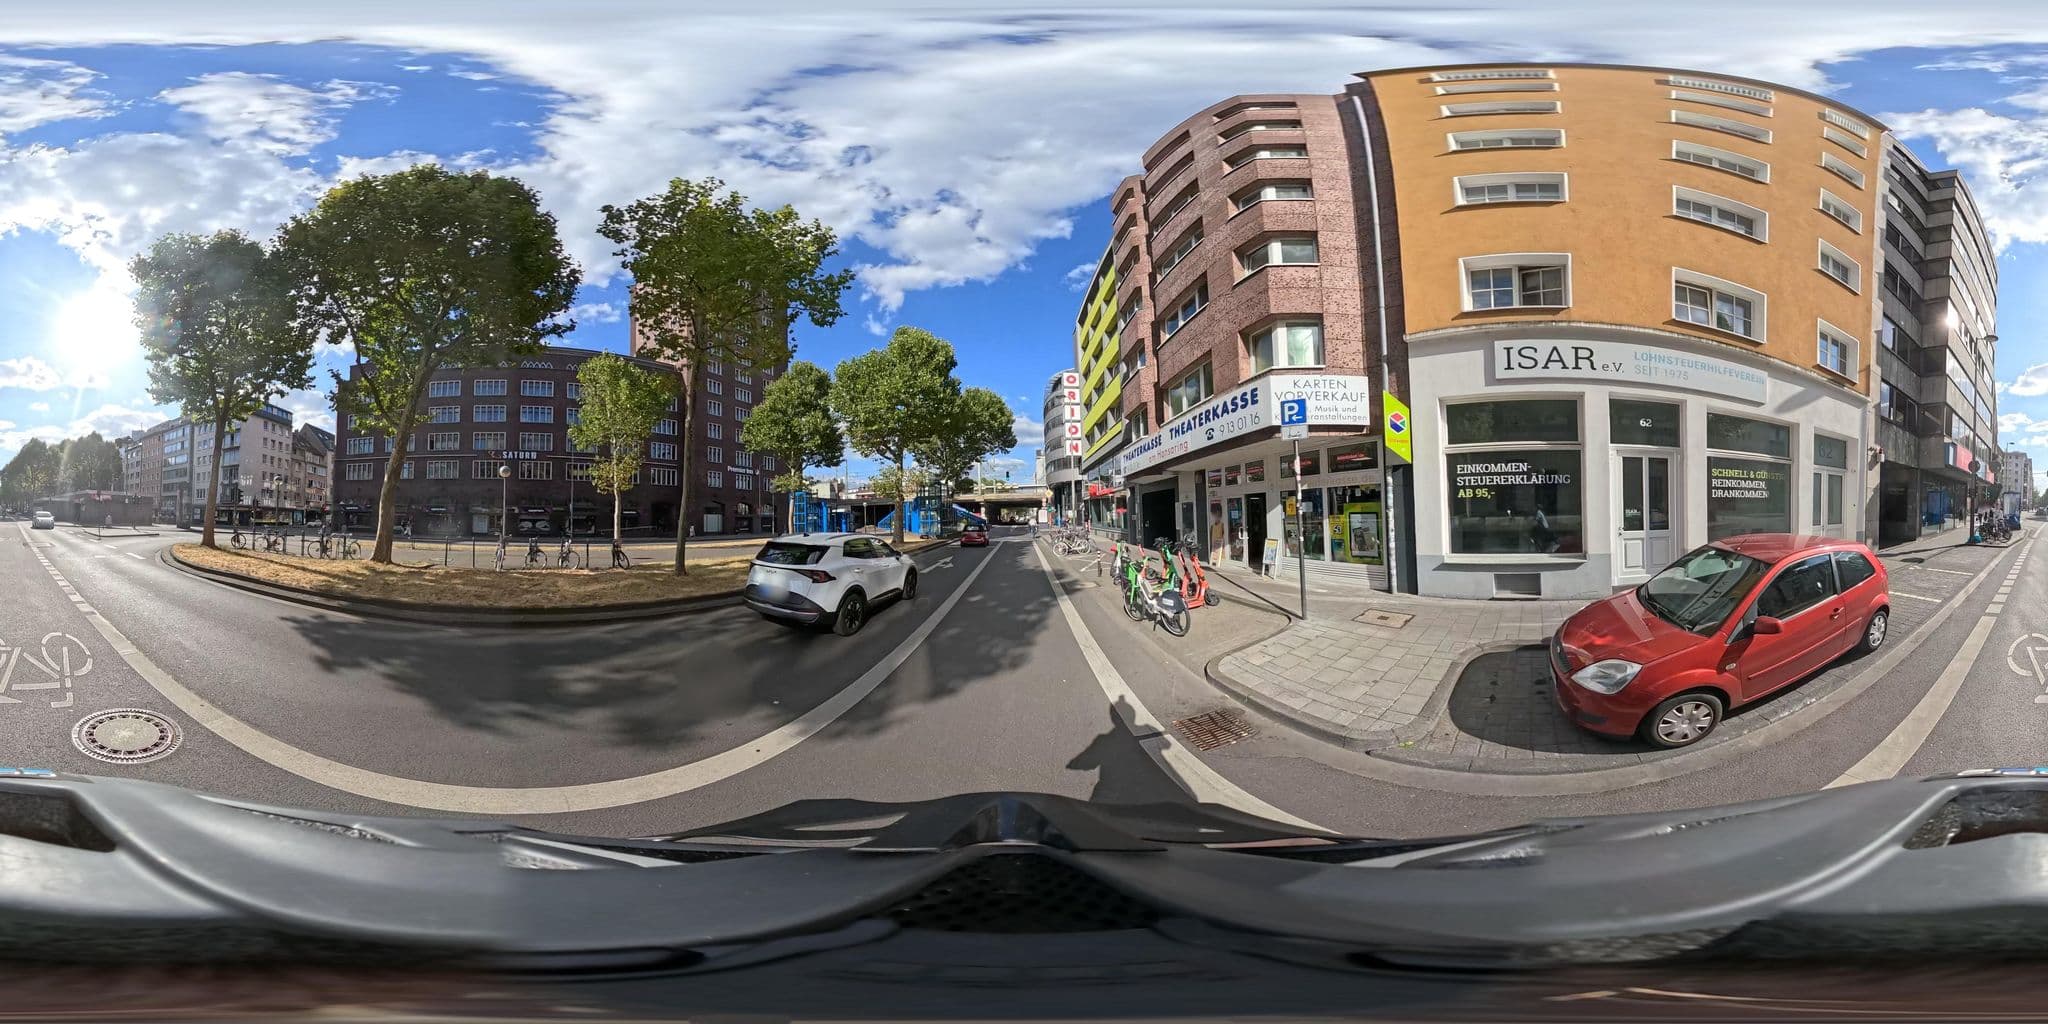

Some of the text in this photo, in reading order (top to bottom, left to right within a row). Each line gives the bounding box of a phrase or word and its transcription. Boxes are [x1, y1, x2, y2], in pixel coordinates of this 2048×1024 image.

[1503, 346, 1624, 374] ISAR e.V.
[1634, 351, 1764, 385] LOHNSTEUERHILFEVEREIN
[1634, 364, 1689, 381] SEIT 1975
[1293, 379, 1347, 389] KARTEN
[1274, 391, 1367, 403] VORVERKAUF
[1066, 374, 1079, 453] ORION
[1169, 387, 1259, 440] THEATERKASSE
[1284, 402, 1299, 422] P
[1314, 405, 1357, 413] Musik und
[1219, 412, 1260, 437] 9 13 01 16
[1640, 418, 1652, 427] 62
[502, 451, 537, 459] SATURN
[1123, 434, 1162, 464] THEATERKASSE
[1456, 463, 1532, 473] EINKOMMEN-
[1712, 468, 1748, 477] SCHNELL
[1456, 473, 1571, 486] STEUERERKLÄRUNG
[1712, 479, 1767, 489] REINKOMMEN,
[1458, 488, 1496, 499] AB 95,-
[1712, 490, 1769, 498] DRANKOMMEN
